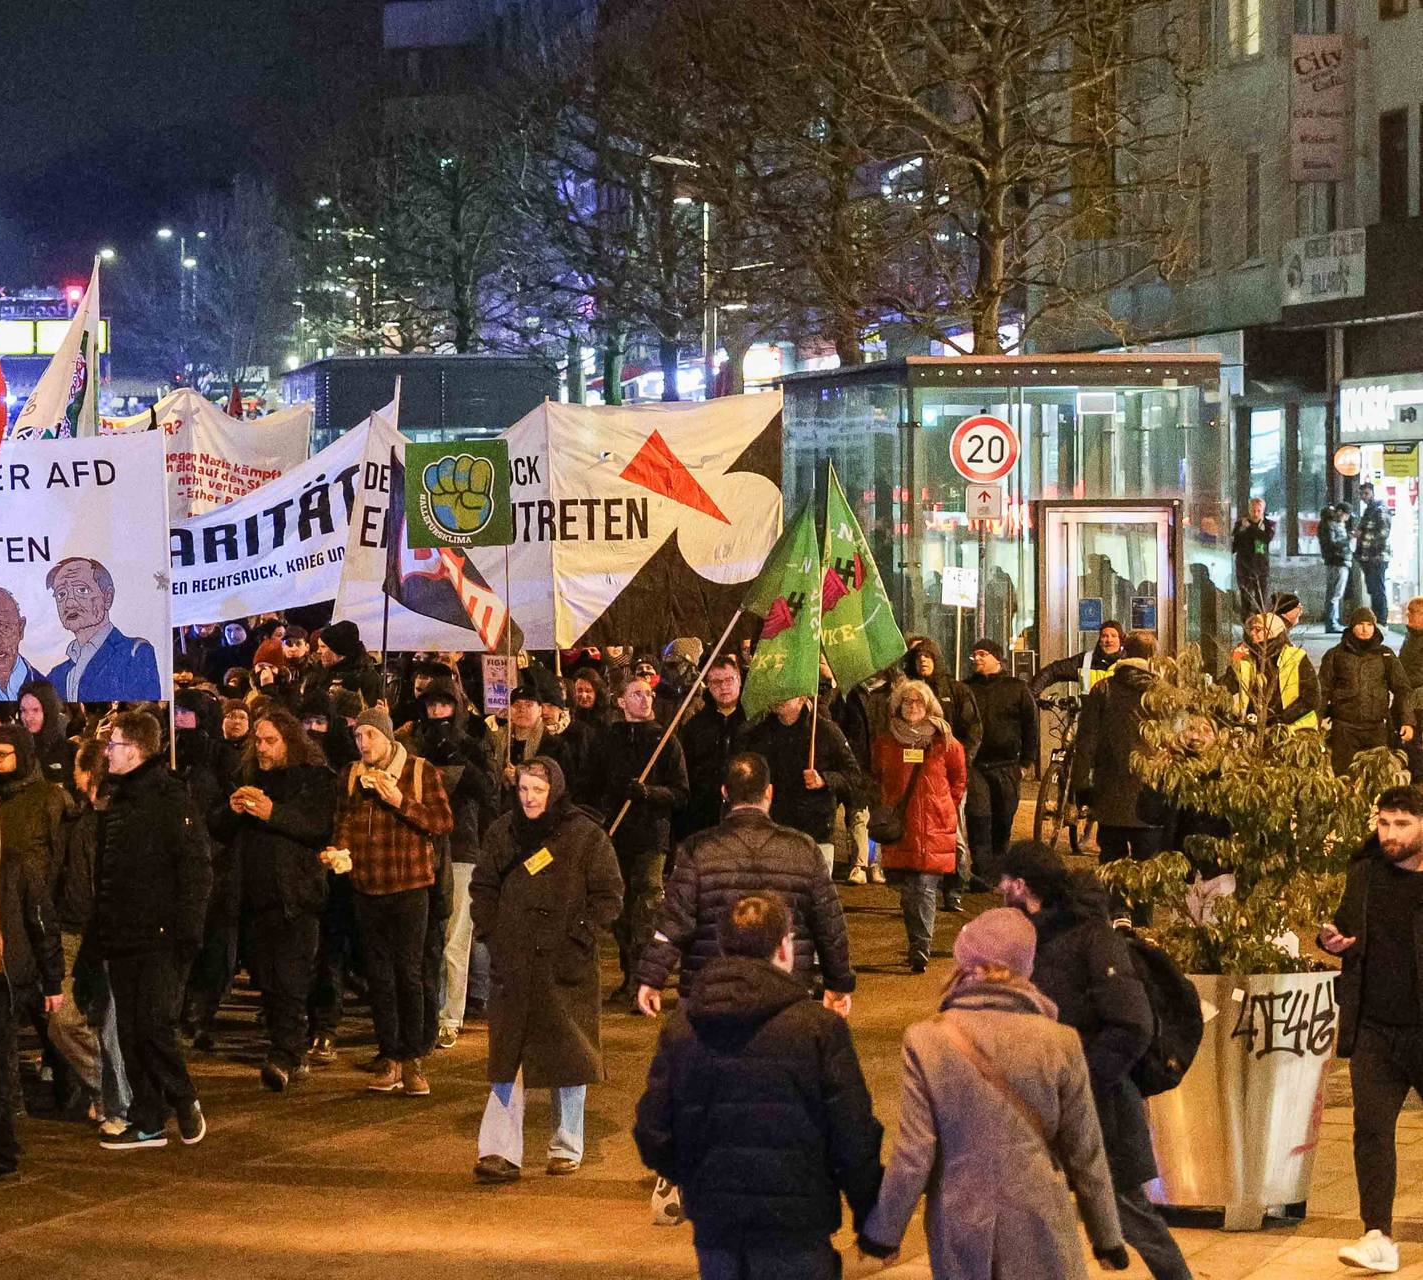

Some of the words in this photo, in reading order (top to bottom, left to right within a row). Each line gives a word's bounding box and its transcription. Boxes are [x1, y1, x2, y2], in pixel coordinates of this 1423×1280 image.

[199, 453, 231, 472] Nazis
[966, 434, 1005, 464] 20
[46, 459, 116, 490] AFD
[198, 466, 220, 478] auf
[221, 470, 245, 487] den
[208, 481, 249, 498] verlas
[363, 461, 390, 494] DE
[170, 463, 361, 569] ARITÄT
[170, 581, 188, 596] EN
[191, 563, 283, 594] RECHTSRUCK,
[286, 551, 325, 575] KRIEG
